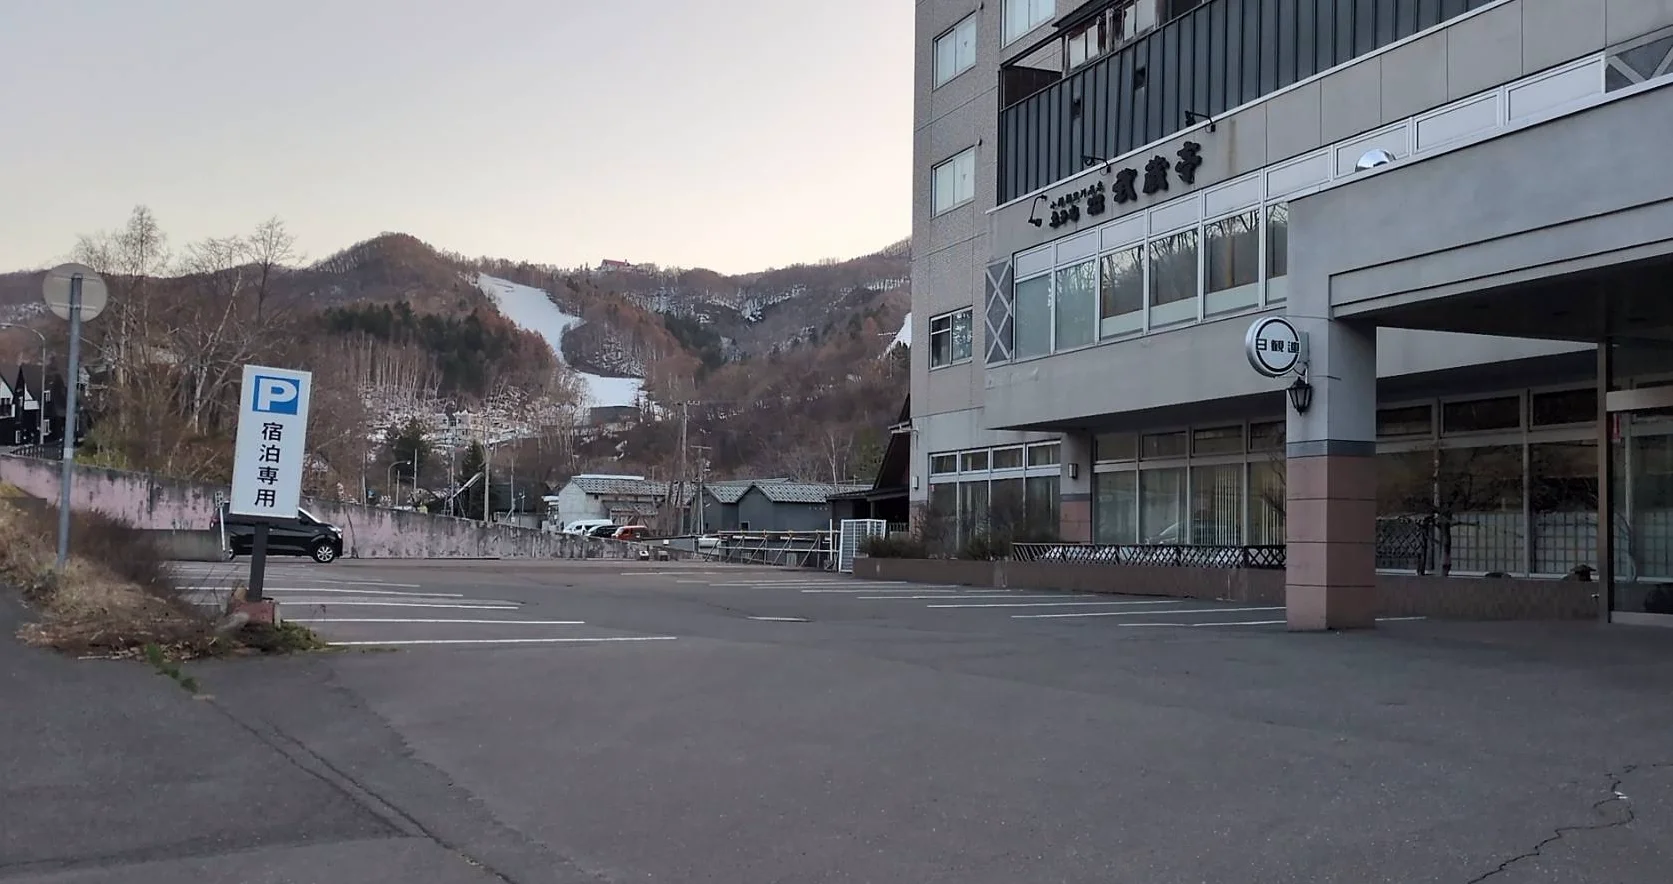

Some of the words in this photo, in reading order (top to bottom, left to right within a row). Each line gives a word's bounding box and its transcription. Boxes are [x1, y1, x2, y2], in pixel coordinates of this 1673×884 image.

[257, 377, 298, 411] P
[254, 421, 284, 508] 宿泊専用
